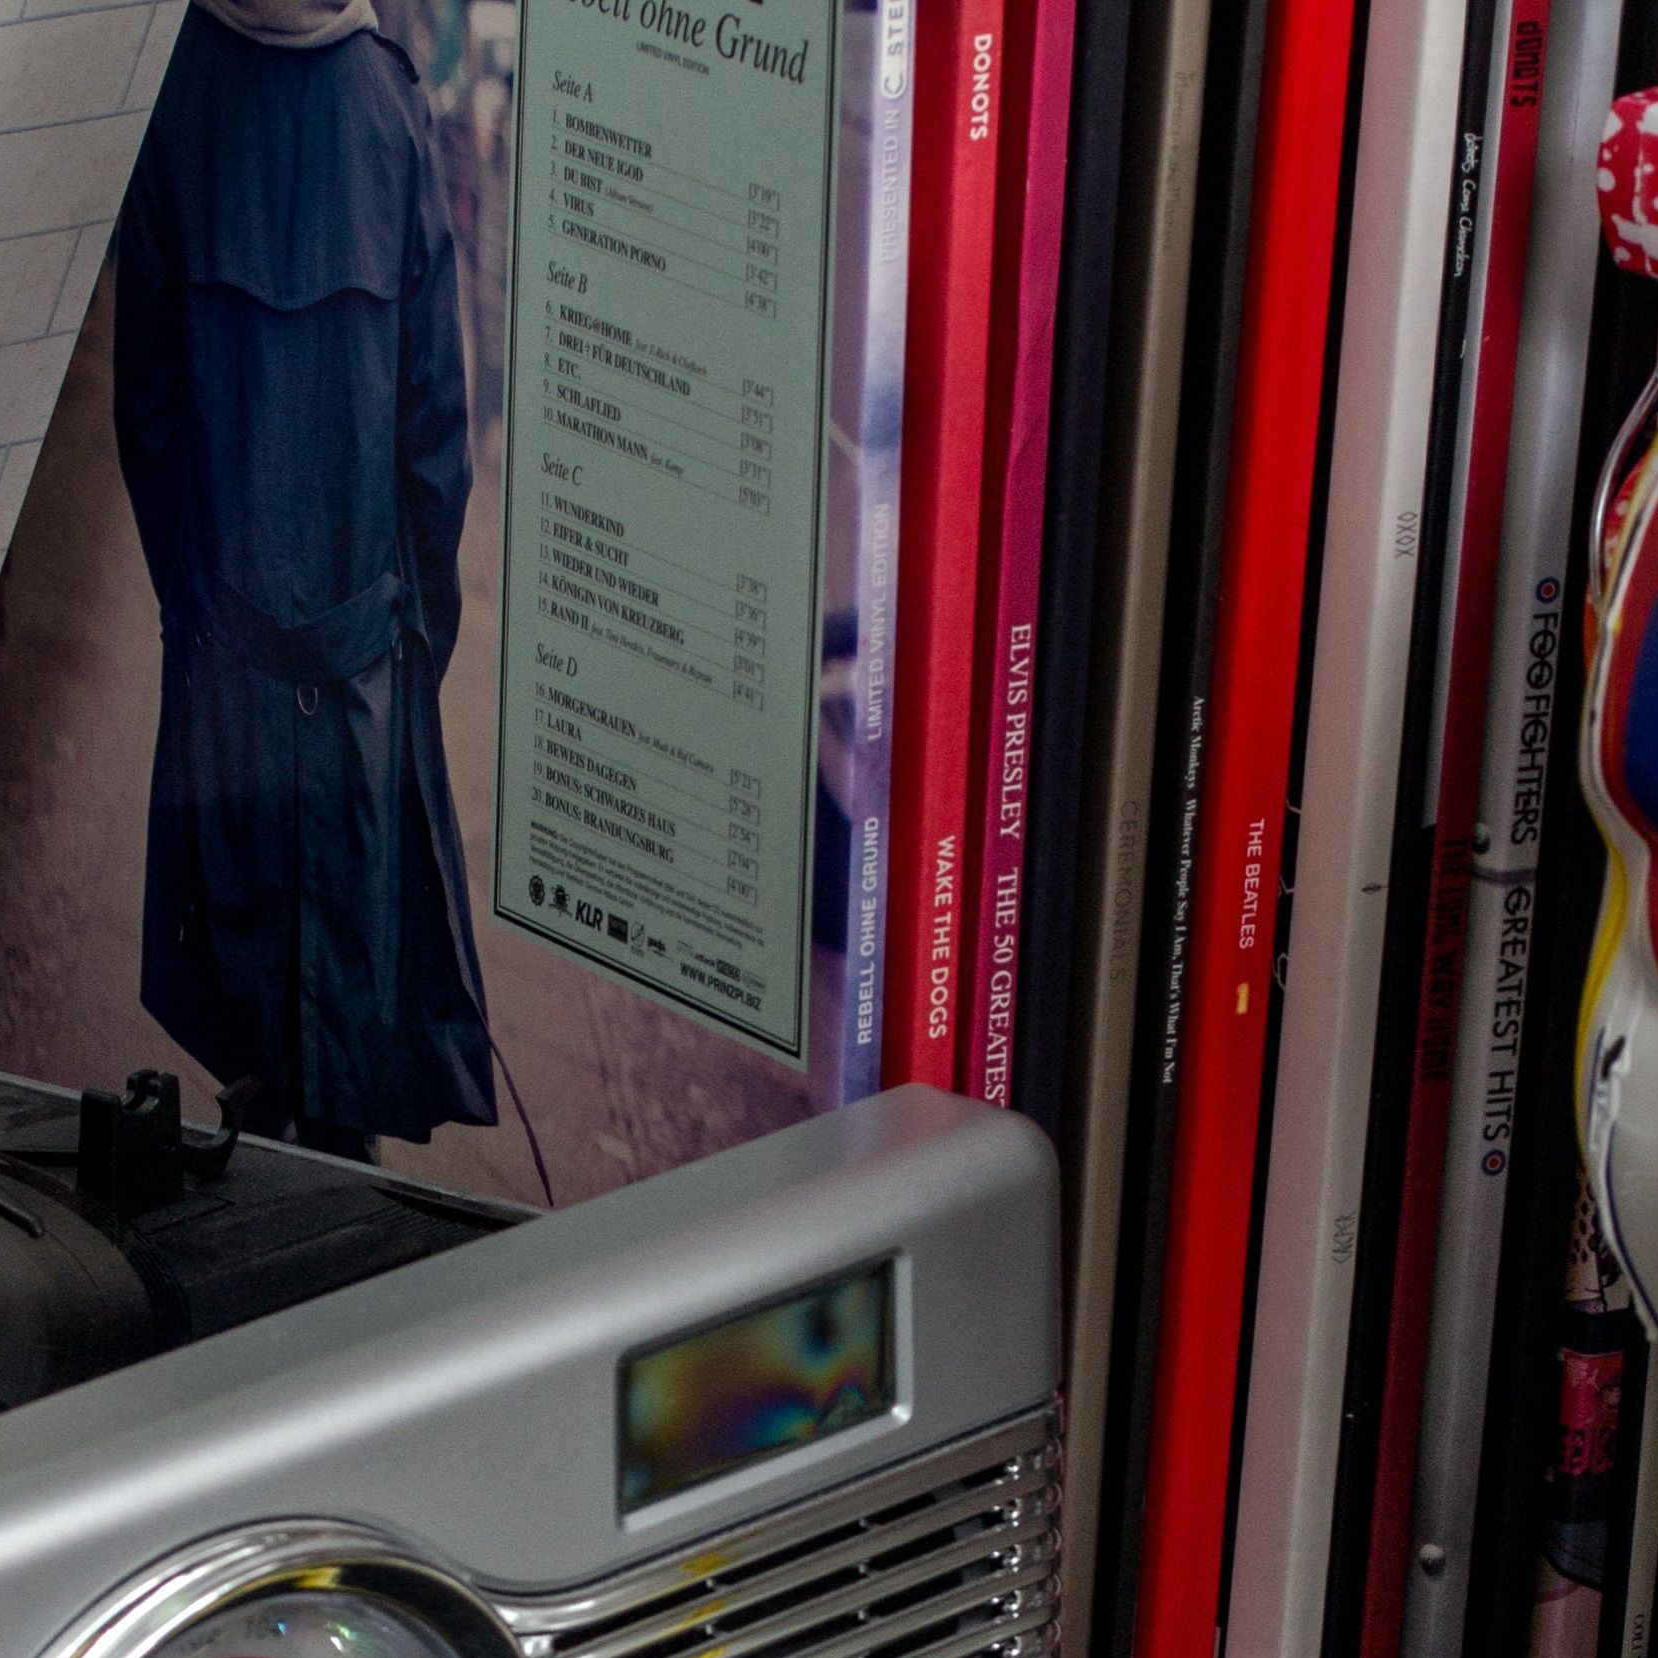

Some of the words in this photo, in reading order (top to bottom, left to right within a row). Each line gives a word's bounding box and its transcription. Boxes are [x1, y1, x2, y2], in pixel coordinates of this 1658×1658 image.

[641, 0, 705, 47] ohne
[716, 13, 809, 84] Grund
[553, 70, 581, 96] Seite
[584, 83, 592, 102] A
[970, 33, 992, 141] DONOTS
[564, 140, 586, 159] DER
[588, 148, 615, 172] NEUE
[617, 160, 643, 182] IGOD
[565, 113, 652, 159] BOMBENWETTER
[563, 192, 593, 216] VIRUS
[564, 166, 579, 185] DU
[581, 173, 603, 193] BIST
[562, 219, 628, 256] GENERATION
[630, 245, 666, 272] PORNO
[547, 260, 575, 289] Seite
[578, 273, 588, 294] B
[558, 358, 582, 380] ETC.
[559, 331, 583, 354] DREI
[593, 344, 612, 366] FÜR
[615, 355, 690, 396] DEUTSCHLAND
[557, 384, 621, 422] SCHLAFLIED
[556, 410, 615, 448] MARATHON
[617, 436, 648, 460] MANN
[541, 452, 569, 481] Seite
[572, 465, 583, 486] C
[554, 496, 624, 538] WUNDERKIND
[1394, 511, 1418, 559] XOXO
[553, 523, 583, 548] EIFER
[595, 541, 629, 566] SUCHT
[872, 503, 890, 587] EDITION
[552, 549, 592, 578] WIEDER
[595, 570, 616, 588] UND
[619, 580, 658, 607] WIEDER
[551, 602, 579, 626] RAND
[552, 574, 596, 606] KÖNIGIN
[598, 596, 619, 616] VON
[622, 607, 684, 645] KREUZBERG
[870, 592, 886, 653] VINYL
[535, 643, 563, 672] Seite
[567, 656, 577, 677] D
[1007, 624, 1032, 706] ELVIS
[1525, 612, 1558, 690] FOO
[548, 687, 635, 738] MORGENGRAUEN
[868, 656, 884, 742] LIMITED
[1192, 696, 1205, 732] Arctic
[547, 713, 582, 742] LAURA
[546, 740, 585, 768] BEWEIS
[587, 759, 637, 791] DAGEGEN
[999, 713, 1027, 839] PRESLEY
[1184, 736, 1202, 790] Monkeys
[1511, 694, 1551, 846] FIGHTERS
[546, 766, 583, 795] BONUS:
[584, 784, 646, 823] SCHWARZES
[648, 812, 675, 837] HAUS
[545, 792, 582, 820] BONUS:
[584, 810, 673, 864] BRANDUNGSBURG
[1180, 798, 1197, 858] Whatever
[1246, 818, 1264, 857] THE
[861, 817, 879, 891] GRUND
[934, 834, 957, 906] WAKE
[1175, 859, 1192, 899] People
[576, 900, 603, 931] KLR
[995, 867, 1019, 928] THE
[1173, 899, 1189, 921] Say
[1239, 863, 1261, 949] BEATLES
[860, 897, 876, 957] OHNE
[931, 911, 952, 960] THE
[994, 936, 1014, 964] 50
[1169, 959, 1184, 1000] That's
[1491, 885, 1531, 1056] GREATEST
[858, 961, 875, 1045] REBELL
[929, 966, 950, 1039] DOGS
[1166, 1001, 1181, 1032] What
[1162, 1062, 1175, 1084] Not
[1482, 1069, 1514, 1142] HITS
